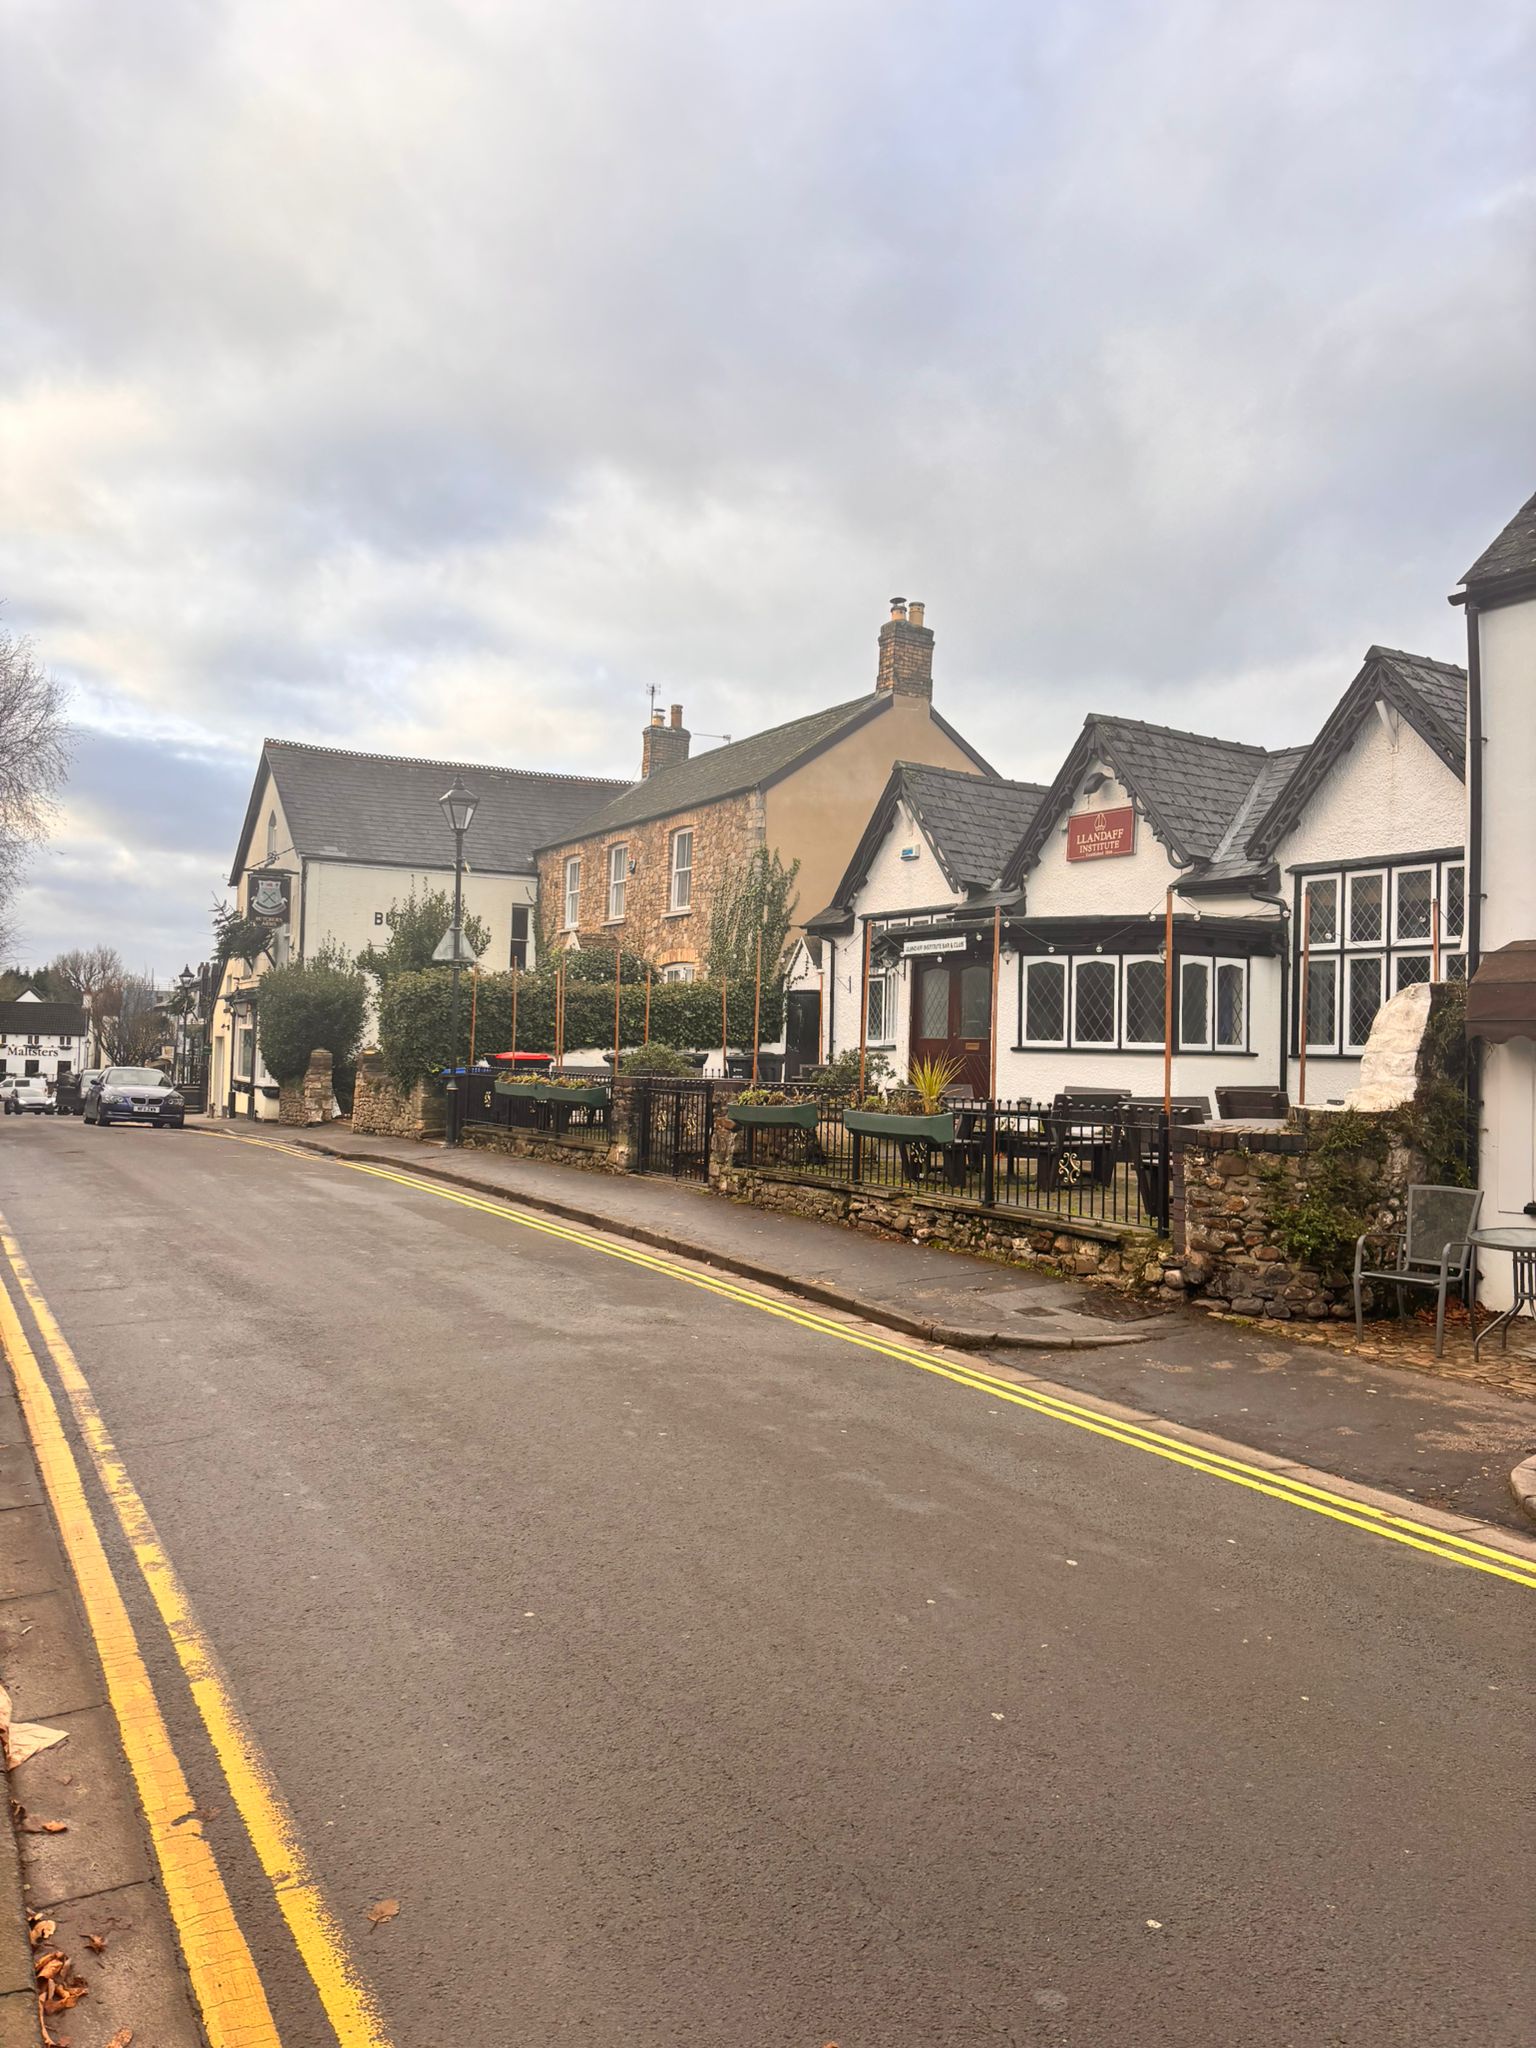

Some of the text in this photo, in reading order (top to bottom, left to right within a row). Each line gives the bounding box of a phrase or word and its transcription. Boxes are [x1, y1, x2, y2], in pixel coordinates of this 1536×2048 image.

[1077, 828, 1124, 845] LLANDAFF
[1080, 840, 1120, 853] INSTITUTE
[7, 1046, 59, 1057] Maltsters
